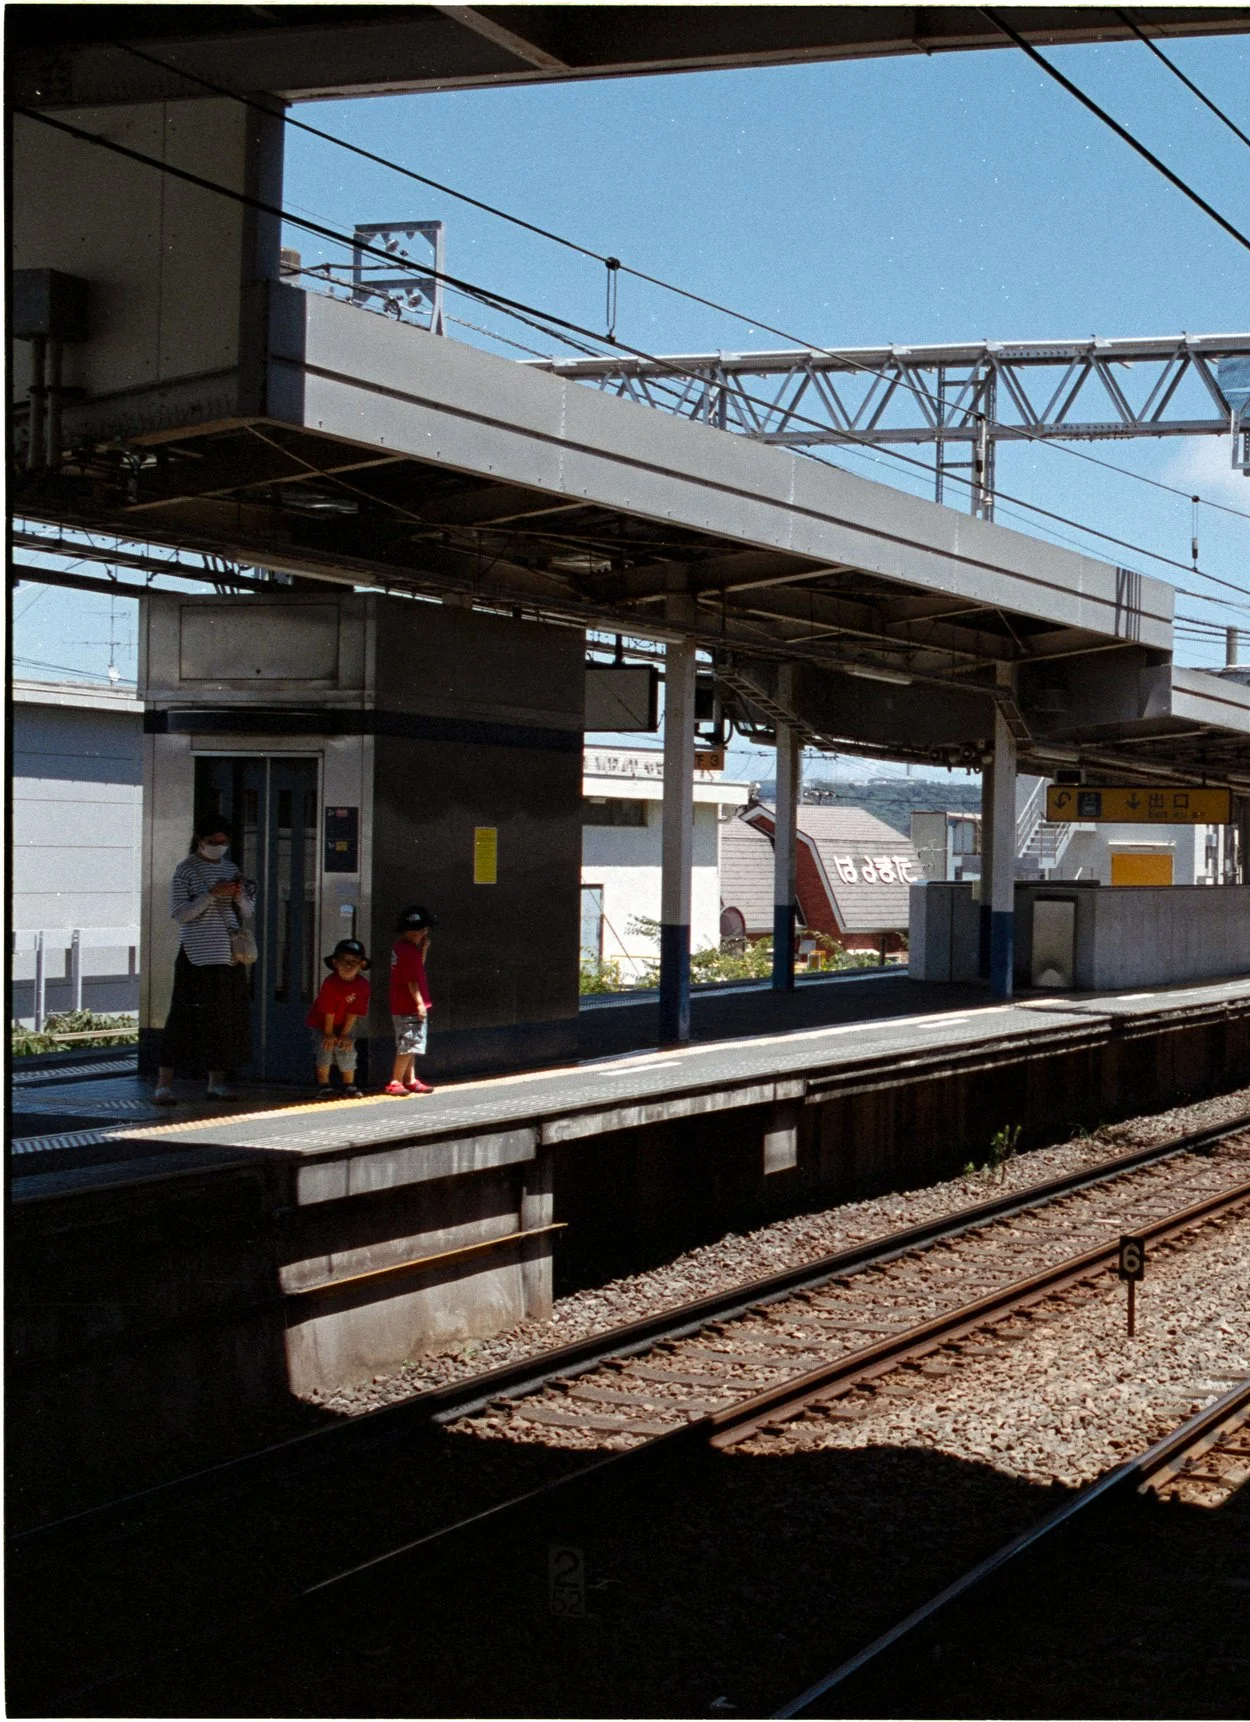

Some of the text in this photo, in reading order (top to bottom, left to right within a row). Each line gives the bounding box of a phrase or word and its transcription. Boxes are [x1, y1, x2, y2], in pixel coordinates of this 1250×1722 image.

[1148, 792, 1189, 808] 出口
[1122, 1242, 1141, 1273] 6
[554, 1551, 579, 1588] 2
